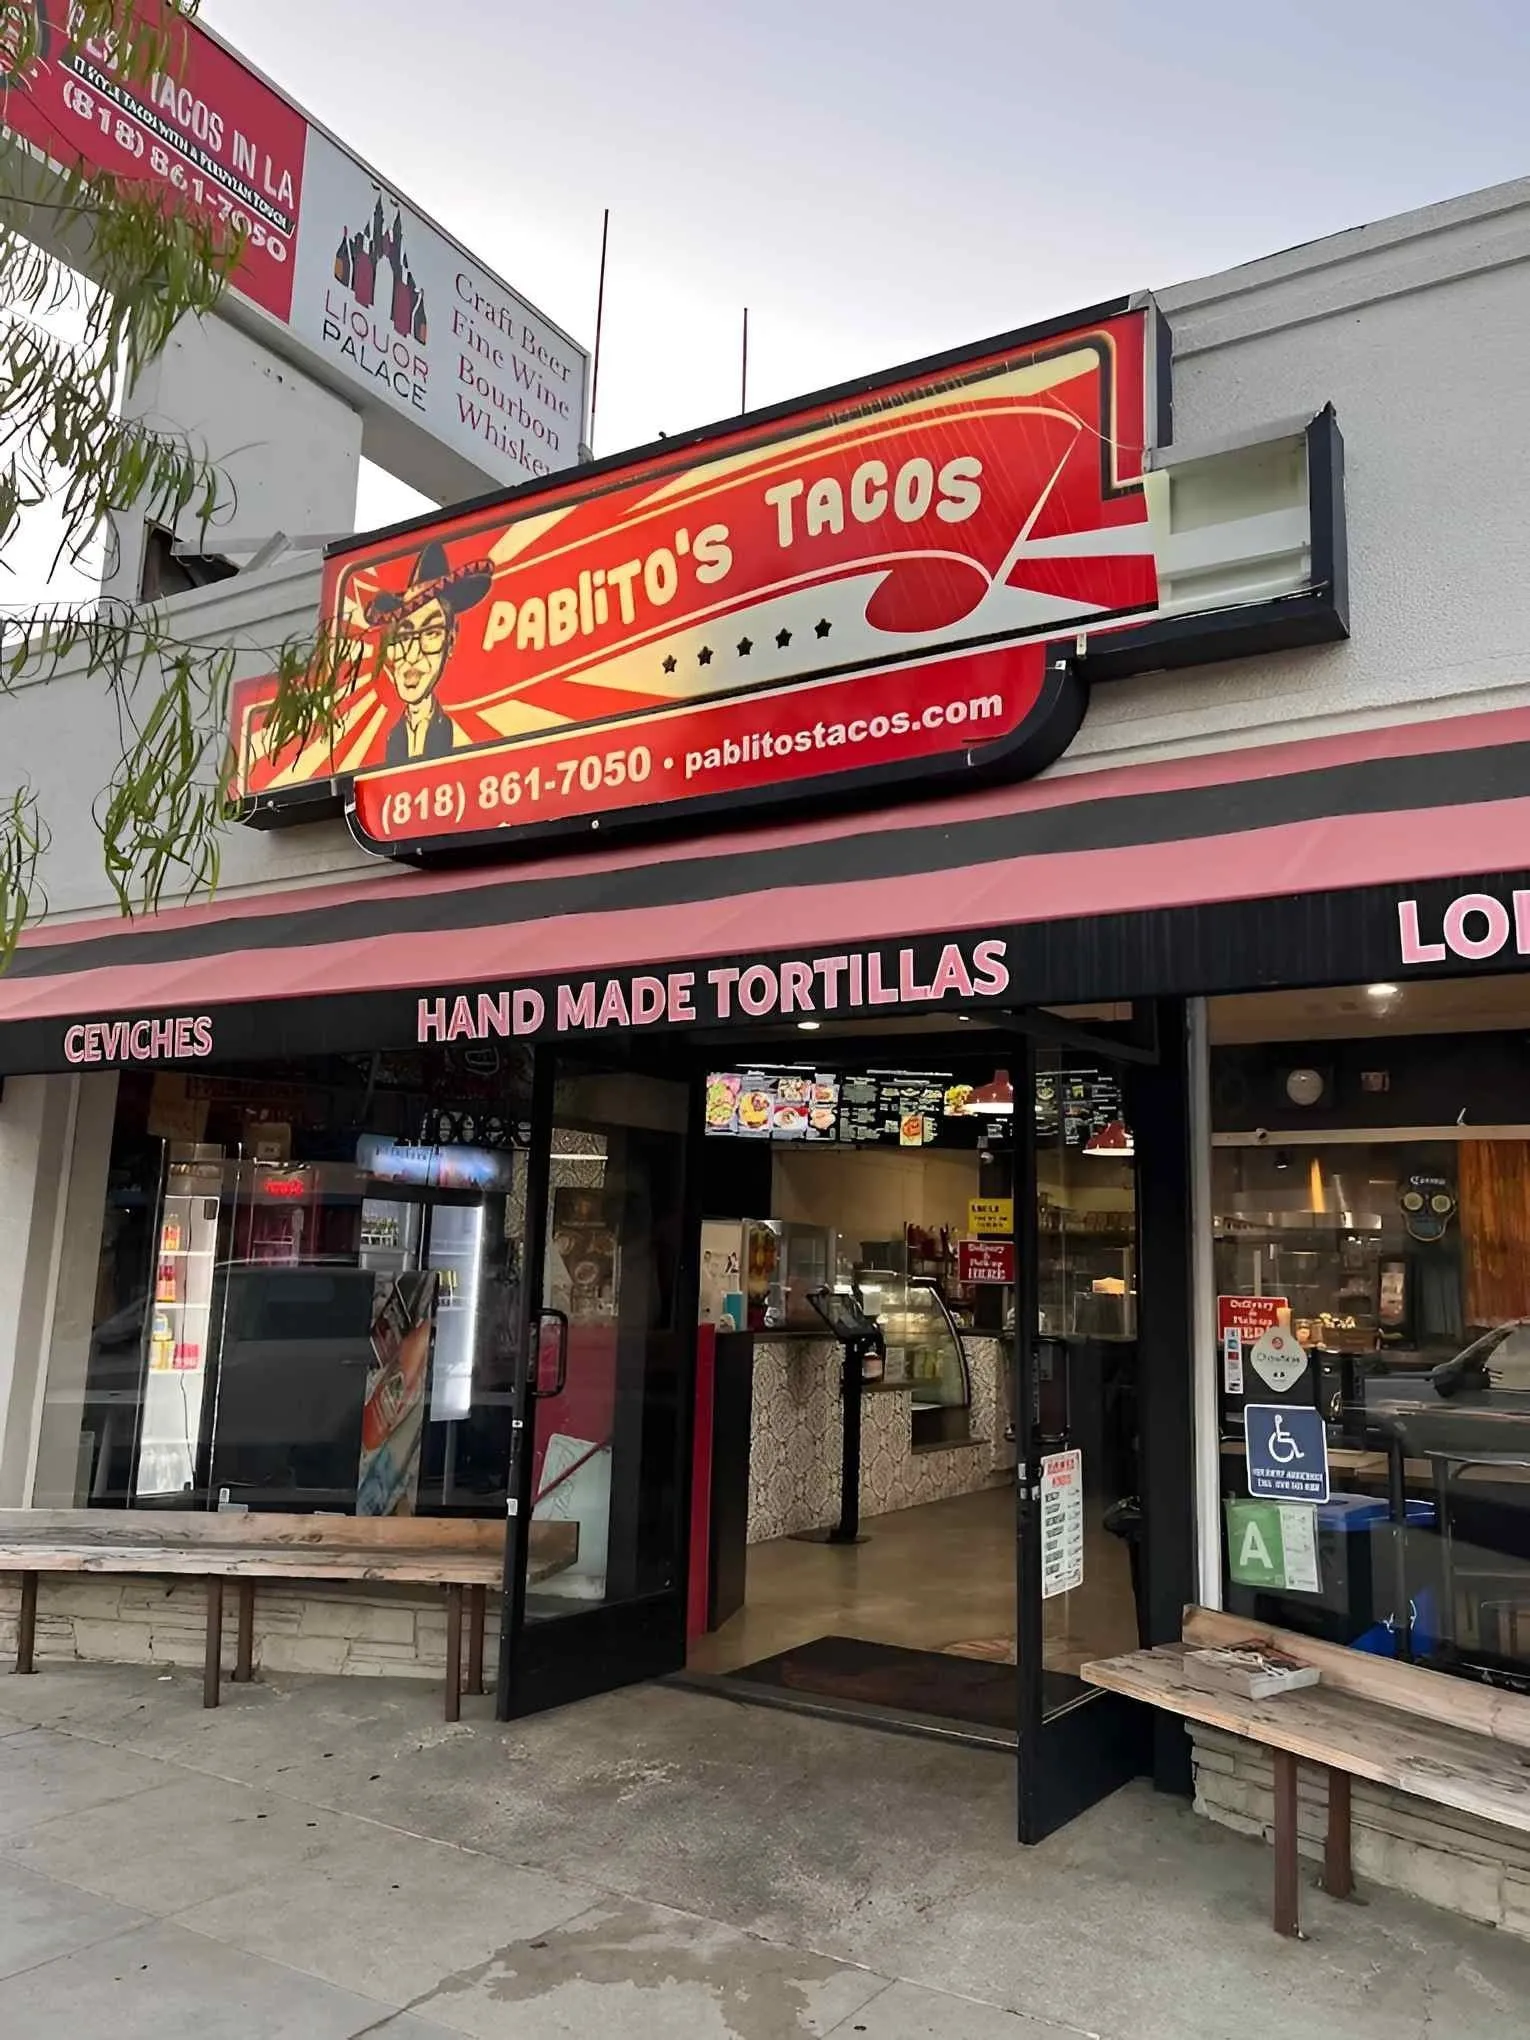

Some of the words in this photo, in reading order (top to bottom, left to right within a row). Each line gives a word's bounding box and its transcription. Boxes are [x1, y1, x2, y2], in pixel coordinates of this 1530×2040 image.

[63, 80, 144, 158] (818)
[150, 146, 287, 263] 861-7050
[232, 129, 256, 180] IN
[264, 154, 294, 210] LA
[323, 320, 427, 412] PALACE
[324, 289, 430, 384] LIQUOR
[452, 306, 505, 369] Fine
[511, 353, 570, 421] Wine
[456, 273, 514, 339] Craft
[521, 326, 572, 384] Beer
[459, 353, 560, 452] Bourbon
[765, 457, 984, 548] TACOS
[381, 780, 467, 835] (818)
[477, 745, 652, 810] 861-7050
[684, 693, 1003, 778] pablitostacos.com
[64, 1016, 214, 1063] CEVICHES
[416, 988, 545, 1043] HAND
[556, 972, 697, 1031] MADE
[707, 939, 1010, 1018] TORTILLAS
[1239, 1521, 1274, 1569] A
